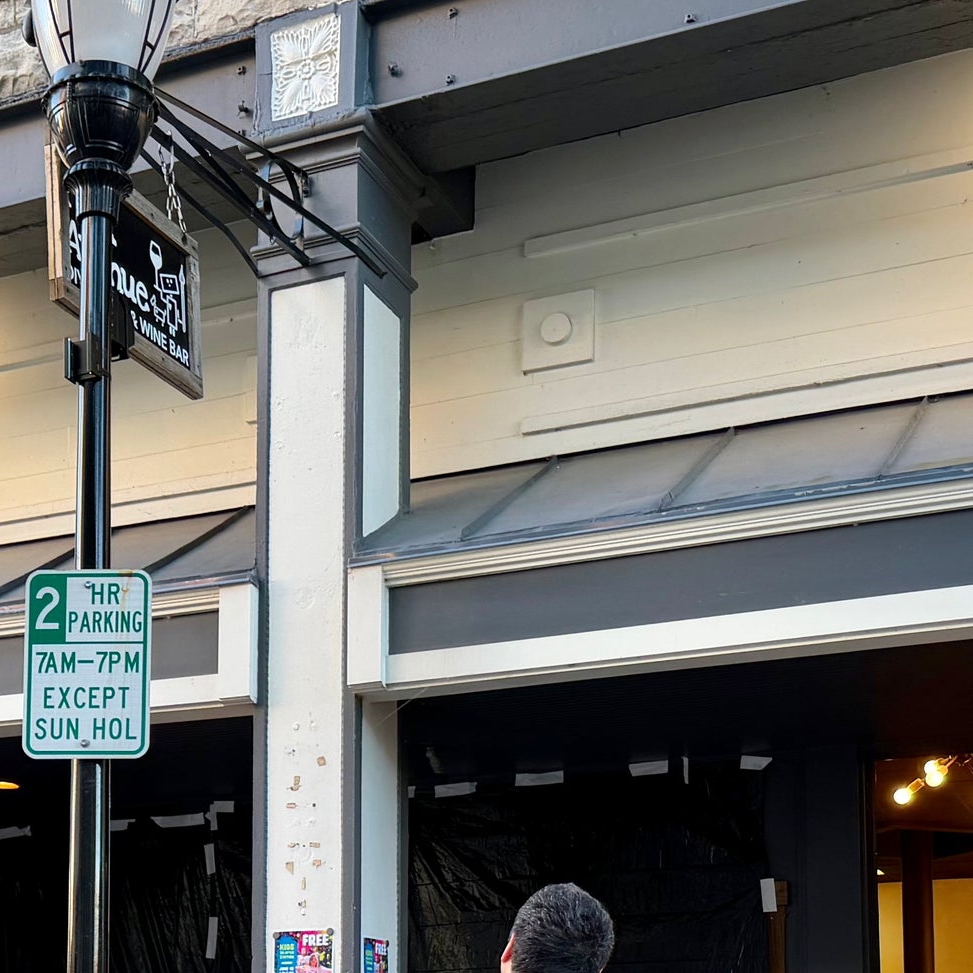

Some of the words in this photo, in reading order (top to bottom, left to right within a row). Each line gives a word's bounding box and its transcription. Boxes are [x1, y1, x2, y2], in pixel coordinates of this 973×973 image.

[130, 310, 139, 330] &
[140, 315, 168, 353] WINE
[169, 338, 191, 366] BAR
[35, 586, 60, 630] 2
[91, 583, 120, 605] HR
[68, 611, 143, 633] PARKING
[43, 687, 130, 709] EXCEPT
[34, 718, 79, 740] SUN
[92, 718, 137, 740] HOL
[302, 934, 329, 947] FREE
[375, 942, 387, 956] FREE
